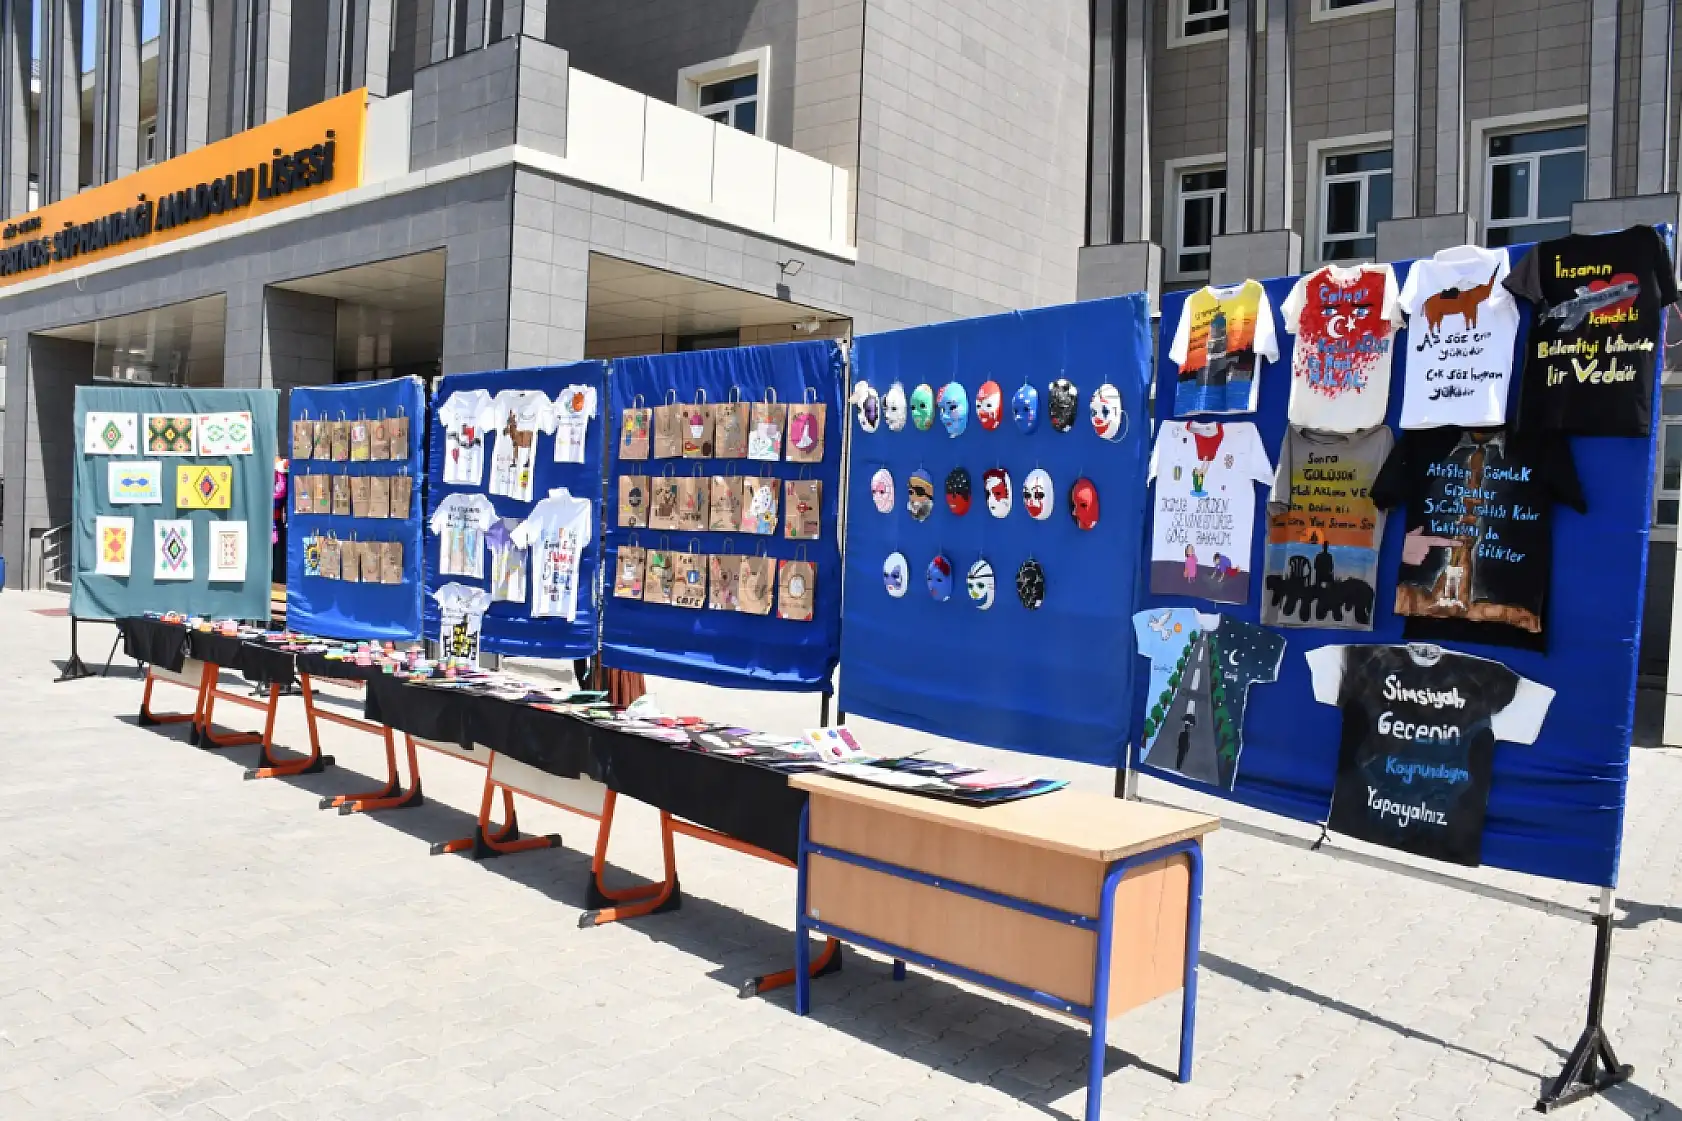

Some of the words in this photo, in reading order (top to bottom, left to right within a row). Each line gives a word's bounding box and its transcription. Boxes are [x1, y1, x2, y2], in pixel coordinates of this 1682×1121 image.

[155, 168, 255, 231] ANADOLU
[258, 129, 336, 200] LİSESİ
[1383, 674, 1467, 710] Simsiyah
[1377, 710, 1462, 746] Gecenin
[1366, 784, 1449, 828] Yapayalnız
